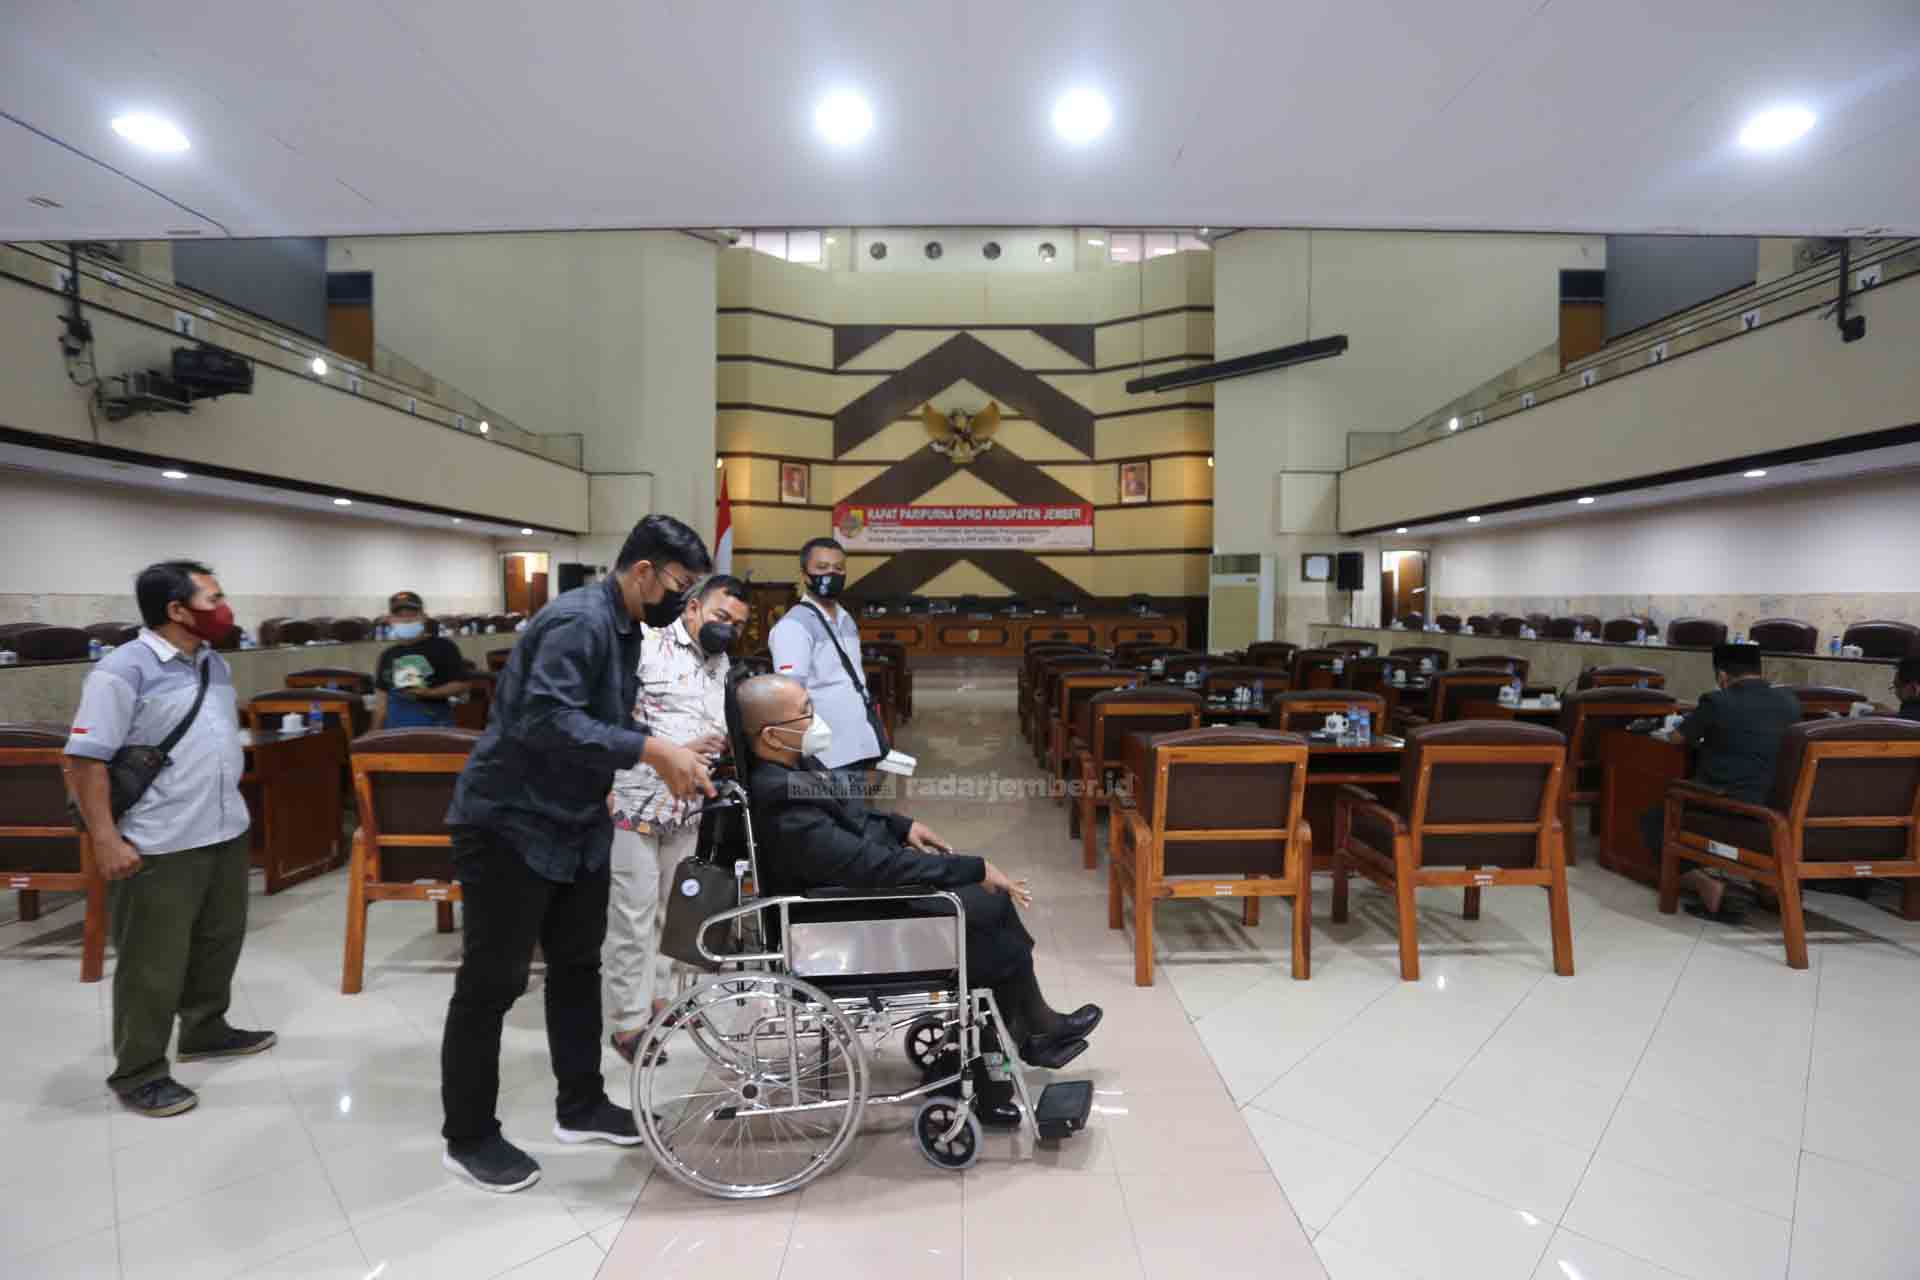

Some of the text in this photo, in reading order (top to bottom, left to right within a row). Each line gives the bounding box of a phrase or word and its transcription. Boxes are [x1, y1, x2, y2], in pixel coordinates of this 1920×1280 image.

[867, 508, 1081, 521] RAPAT PARIPURNA DPRD KABUPATEN JEMBER
